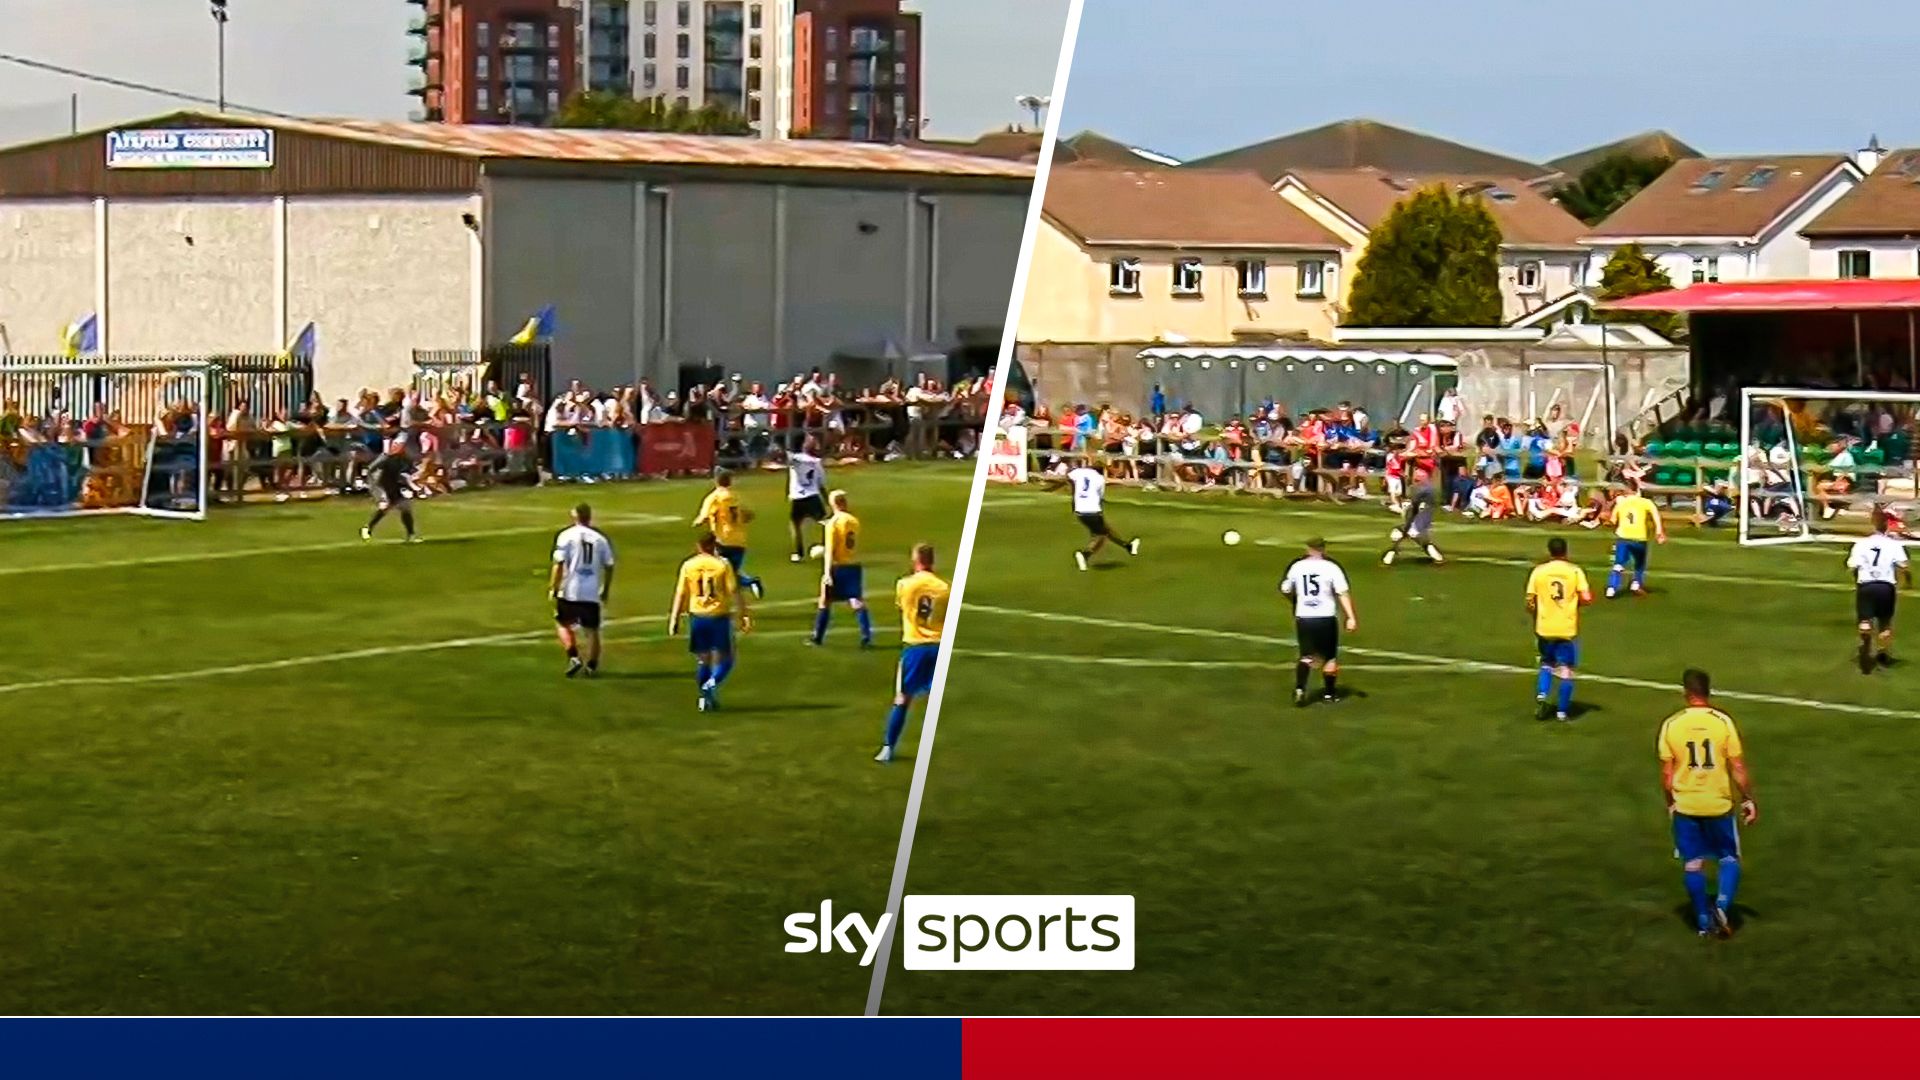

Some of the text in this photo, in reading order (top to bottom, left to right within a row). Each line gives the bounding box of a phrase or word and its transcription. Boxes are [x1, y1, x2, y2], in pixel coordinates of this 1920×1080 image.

[1870, 547, 1880, 566] 7
[697, 575, 715, 597] 11
[1302, 574, 1319, 596] 15
[1551, 581, 1564, 601] 3
[1686, 738, 1714, 769] 11
